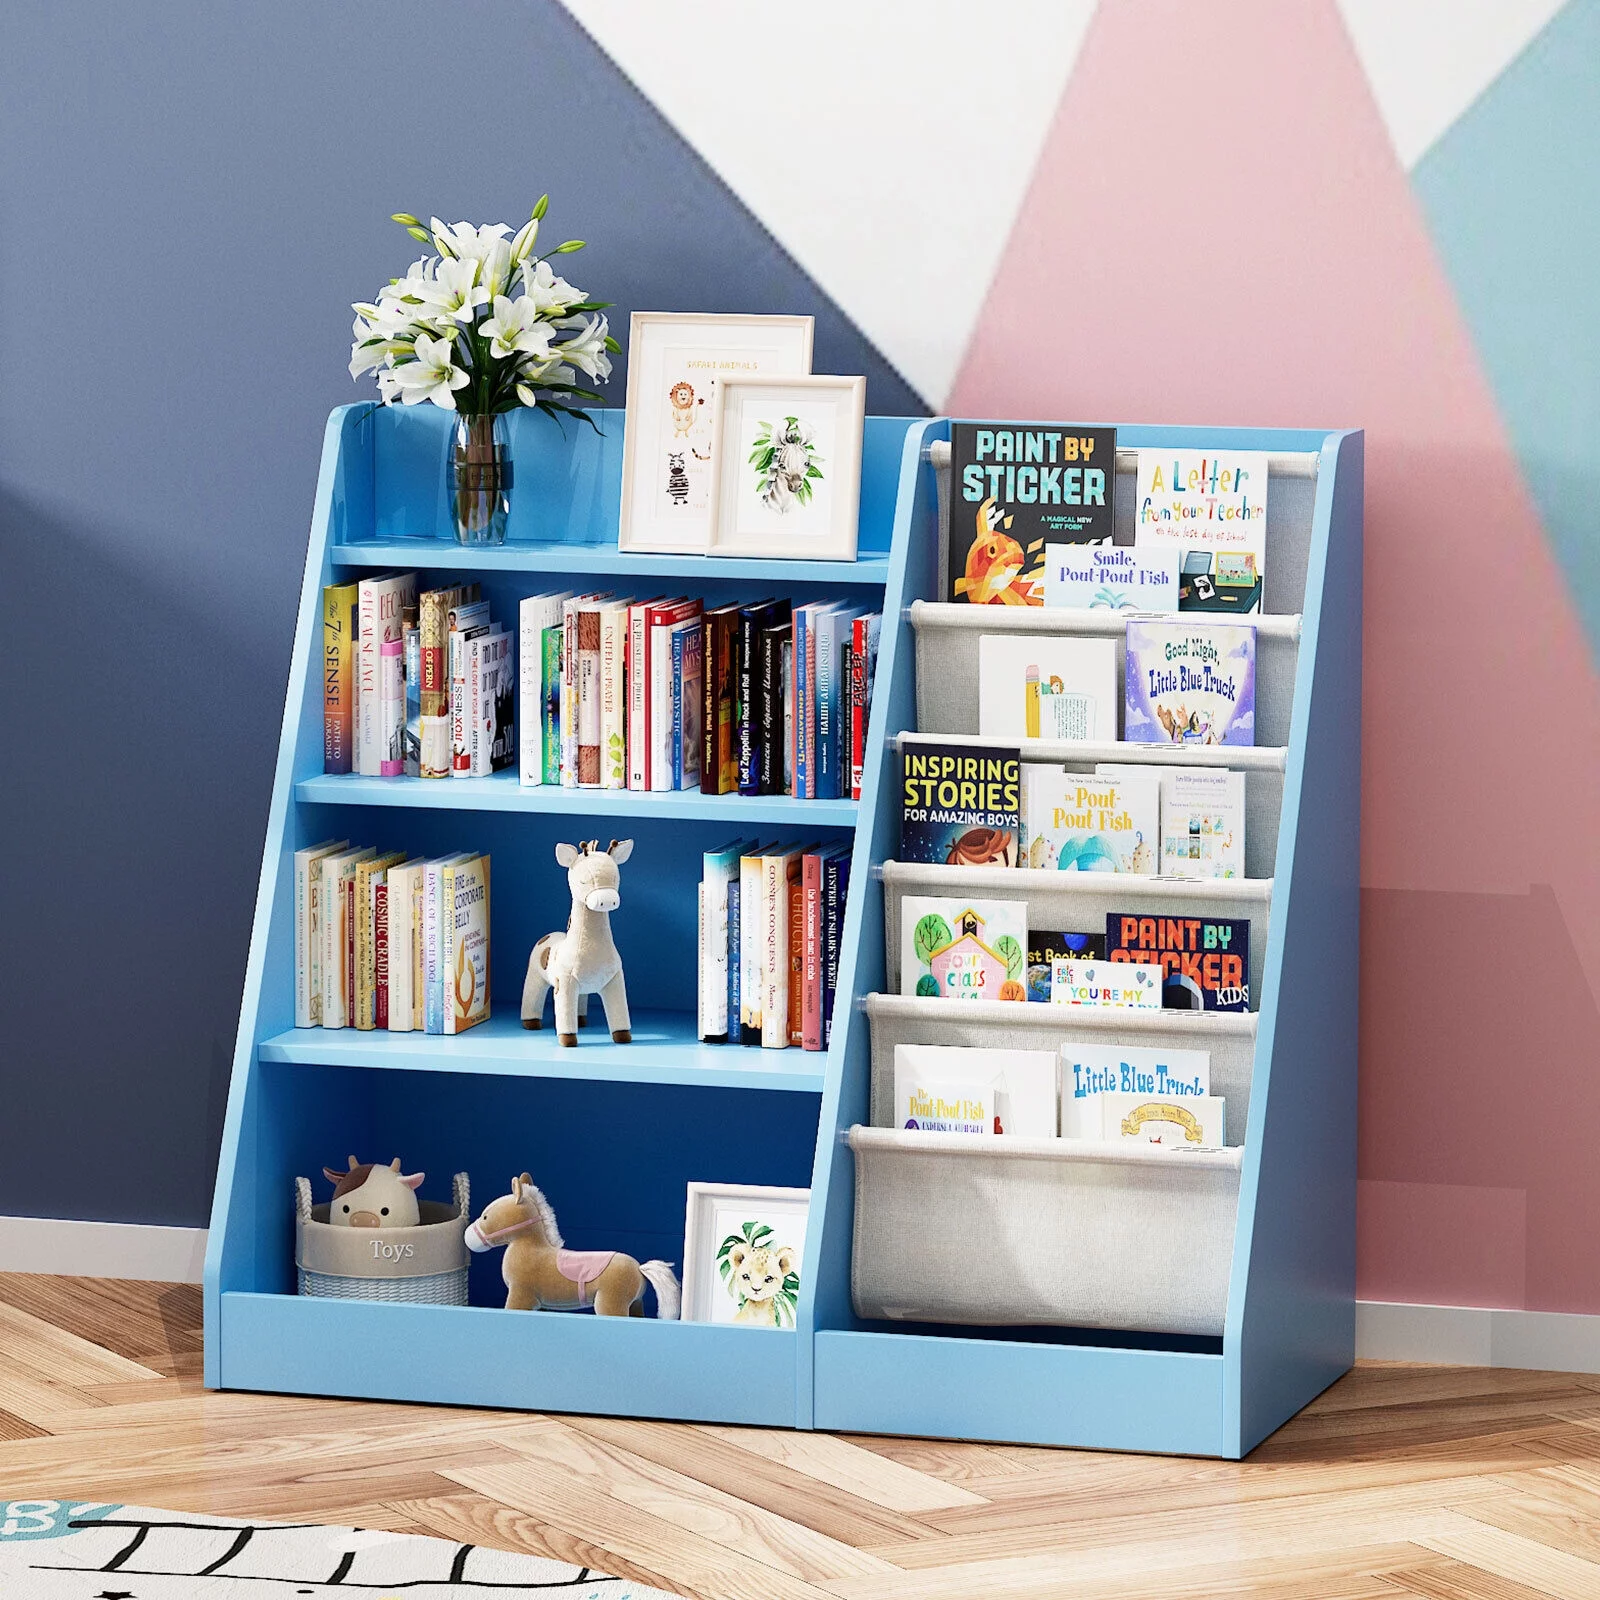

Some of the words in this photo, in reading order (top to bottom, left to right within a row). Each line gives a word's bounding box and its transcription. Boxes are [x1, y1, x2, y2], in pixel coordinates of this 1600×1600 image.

[687, 360, 716, 369] SAFARI
[719, 361, 758, 370] ANIMALS
[976, 430, 1061, 463] PAINT
[1065, 436, 1094, 462] BY
[962, 464, 1106, 506] STICKER
[1152, 465, 1164, 493] A
[1173, 459, 1249, 494] Letter
[1047, 516, 1076, 524] MAGICAL
[1141, 497, 1171, 523] from
[1205, 497, 1264, 522] Teacher
[1064, 523, 1083, 531] FORM
[1093, 550, 1136, 567] Smile,
[1060, 567, 1136, 584] Pout-Pout
[1140, 569, 1169, 585] Fish
[329, 600, 339, 618] The
[425, 650, 433, 663] OF
[605, 626, 613, 666] UNITED
[1165, 638, 1188, 661] Good
[1192, 639, 1220, 666] Night,
[327, 646, 340, 706] SENSE
[425, 664, 433, 688] PERN
[605, 666, 613, 676] IN
[741, 674, 749, 688] Roll
[472, 687, 478, 696] OF
[605, 678, 613, 713] PRAYER
[741, 688, 749, 702] and
[1149, 670, 1177, 698] Little
[1180, 666, 1203, 697] Blue
[1203, 666, 1235, 701] Truck
[741, 702, 749, 720] Rock
[763, 694, 772, 728] берегов
[820, 701, 828, 736] НАШИ
[334, 746, 341, 760] TO
[741, 730, 749, 766] Zeppelin
[762, 742, 770, 784] Записки
[905, 754, 1018, 782] INSPIRING
[741, 768, 749, 784] Led
[904, 779, 1018, 811] STORIES
[1075, 787, 1120, 809] Pout-
[904, 808, 927, 822] FOR
[930, 810, 984, 826] AMAZING
[987, 813, 1018, 828] BOYS
[1052, 807, 1092, 830] Pout
[1098, 809, 1133, 832] Fish
[428, 872, 436, 906] DANCE
[455, 874, 464, 891] FIRE
[768, 865, 776, 912] CONNIE'S
[828, 866, 836, 908] MYSTERY
[454, 885, 484, 910] CORPORATE
[377, 890, 388, 936] COSMIC
[428, 908, 436, 920] OF
[455, 910, 470, 929] BELLY
[792, 893, 802, 953] CHOICES
[828, 910, 836, 920] AT
[428, 934, 436, 956] RICH
[768, 914, 776, 973] CONQUESTS
[828, 922, 836, 960] SHARK'S
[1120, 917, 1202, 952] PAINT
[1204, 924, 1232, 949] BY
[808, 940, 816, 955] man
[377, 939, 388, 986] CRADLE
[428, 959, 436, 983] YOGI
[952, 954, 980, 969] our
[1057, 965, 1074, 977] ERIC
[828, 961, 836, 989] TEETH
[947, 970, 985, 987] class
[1071, 987, 1119, 1001] YOU'RE
[1123, 989, 1143, 1002] MY
[1215, 983, 1248, 1006] KIDS
[1073, 1063, 1116, 1099] Little
[1120, 1062, 1154, 1093] Blue
[917, 1088, 928, 1100] The
[909, 1096, 960, 1120] Pout-Pout
[963, 1100, 984, 1121] Fish
[369, 1240, 414, 1263] Toys
